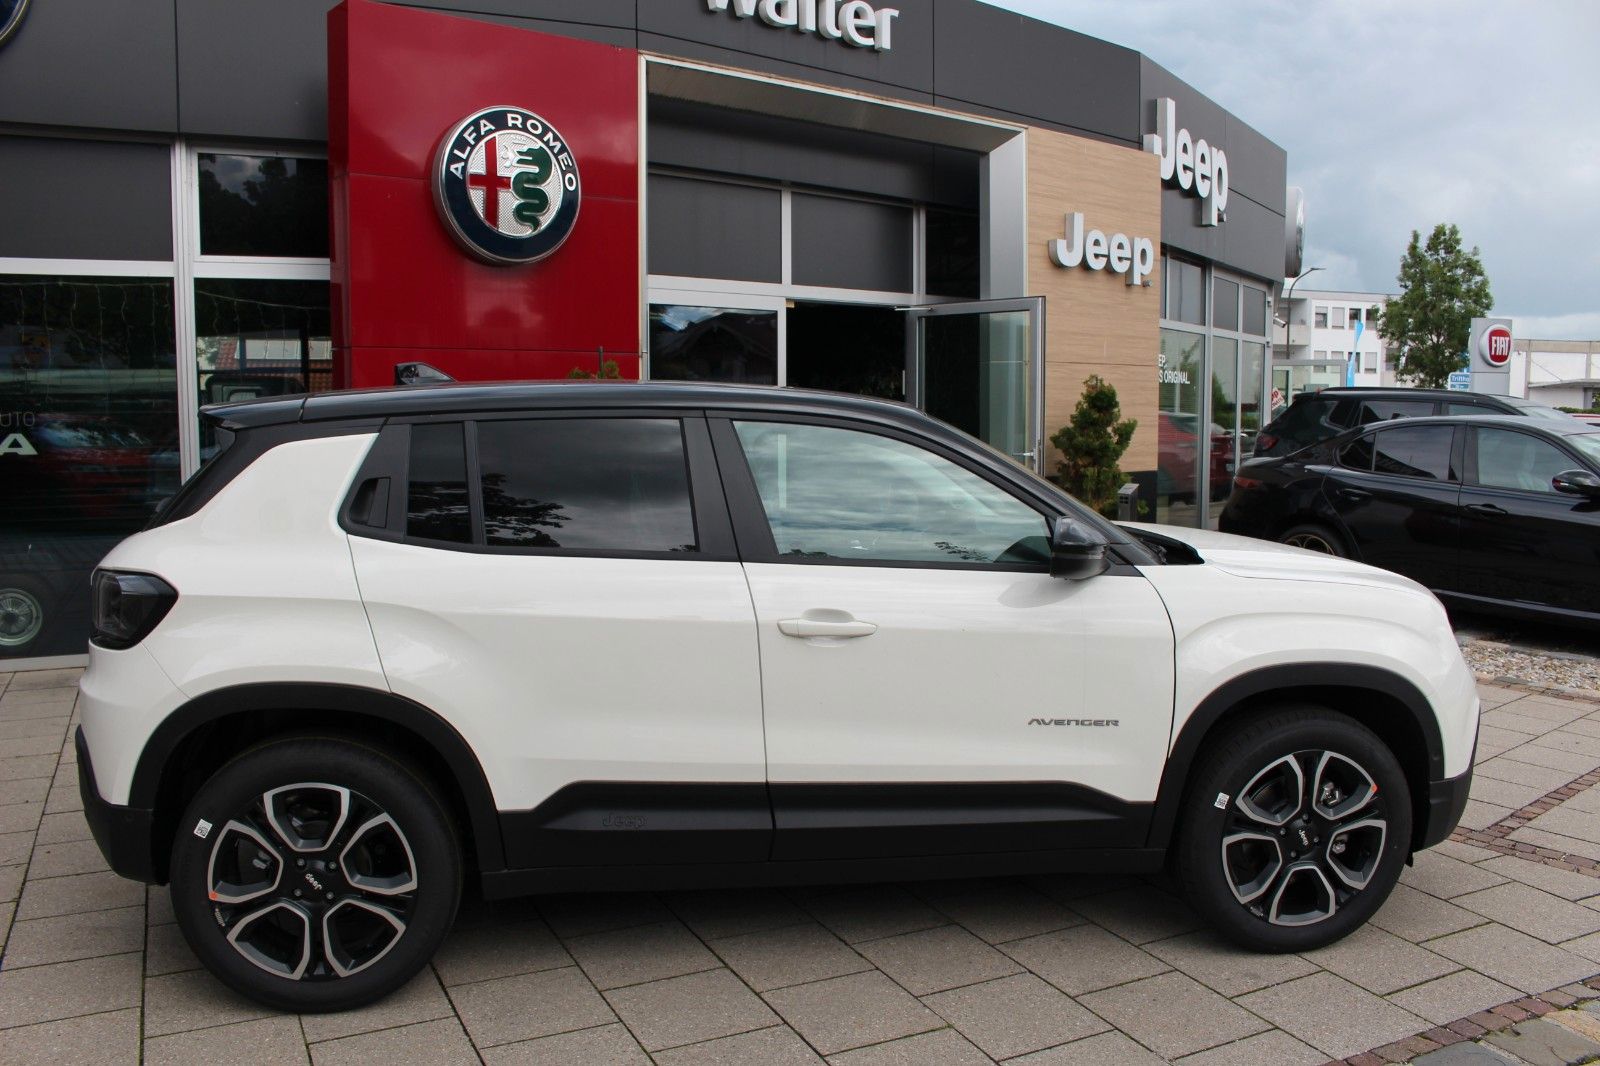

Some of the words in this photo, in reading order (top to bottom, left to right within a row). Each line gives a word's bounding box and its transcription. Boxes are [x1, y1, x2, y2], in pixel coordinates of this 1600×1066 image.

[449, 119, 496, 180] ALFA
[506, 113, 577, 192] ROMEO
[1142, 97, 1229, 227] Jeep
[1048, 212, 1154, 286] Jeep
[1491, 336, 1510, 356] FIAT
[1027, 718, 1120, 727] AVENGER
